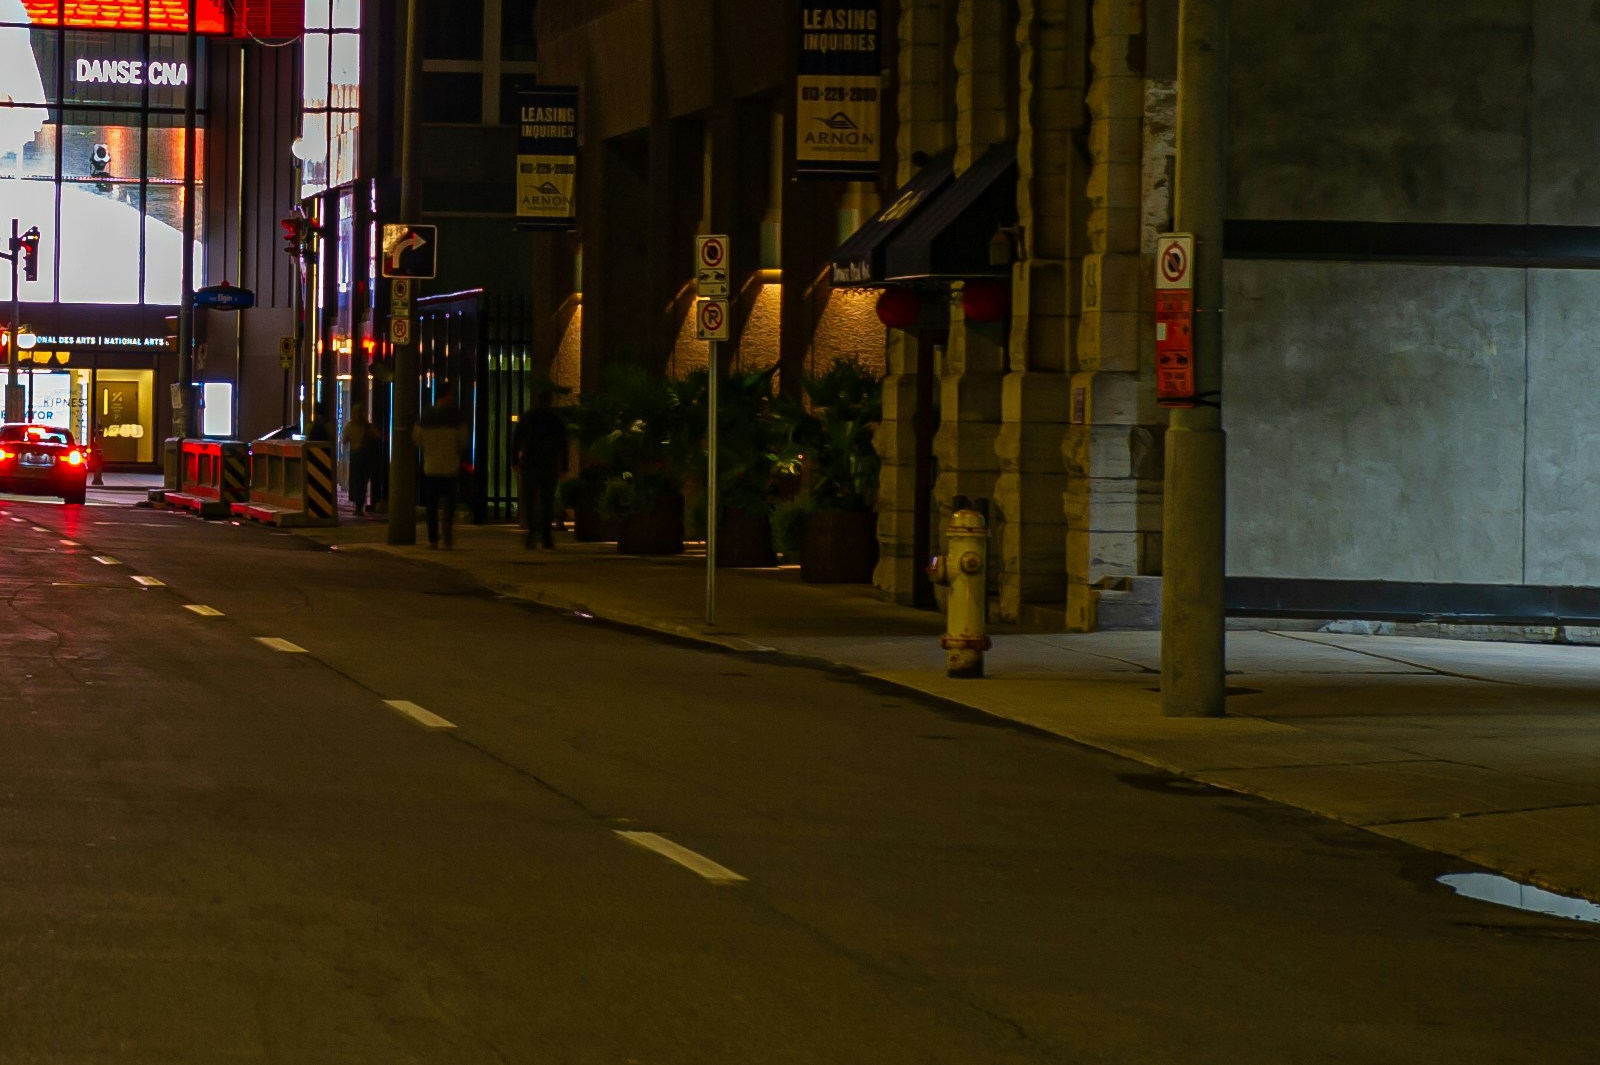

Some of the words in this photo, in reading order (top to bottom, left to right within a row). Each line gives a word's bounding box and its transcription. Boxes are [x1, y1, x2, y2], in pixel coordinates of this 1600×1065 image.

[803, 9, 878, 30] LEASING
[804, 33, 876, 53] INQUIRIES
[77, 58, 143, 84] DANSE
[148, 61, 188, 85] CNA
[521, 106, 575, 122] LEASING
[521, 125, 574, 140] INQUIRIES
[804, 131, 874, 146] ARNON
[522, 195, 574, 206] ARNON
[59, 335, 74, 344] DES
[75, 336, 96, 344] ARTS
[104, 337, 142, 346] NATIONAL
[144, 337, 164, 346] ARTS
